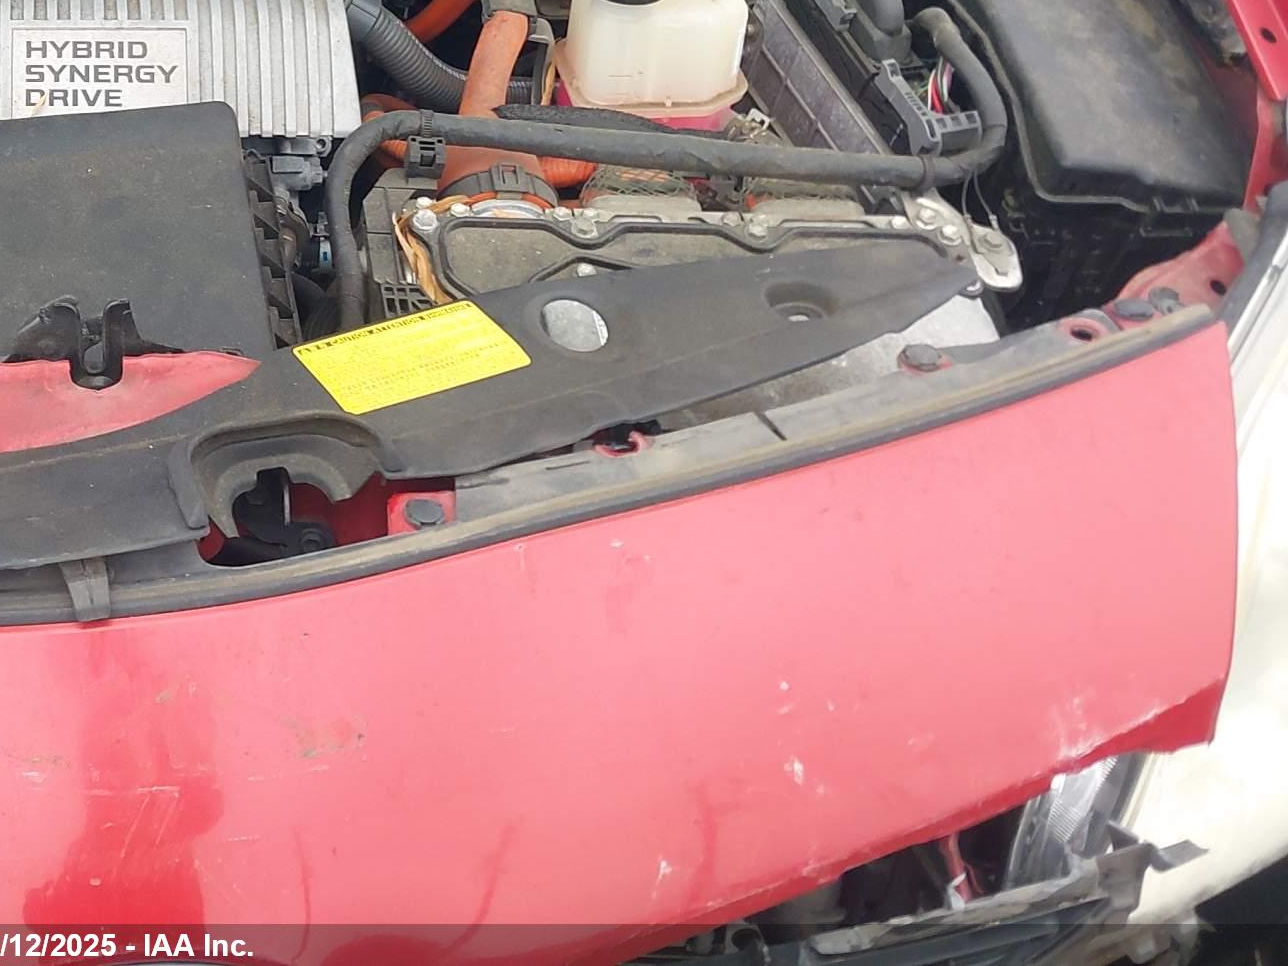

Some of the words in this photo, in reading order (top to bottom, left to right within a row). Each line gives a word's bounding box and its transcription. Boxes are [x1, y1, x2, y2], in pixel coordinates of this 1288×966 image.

[25, 41, 147, 59] HYBRID
[25, 64, 179, 83] SYNERGY
[25, 89, 123, 107] DRIVE
